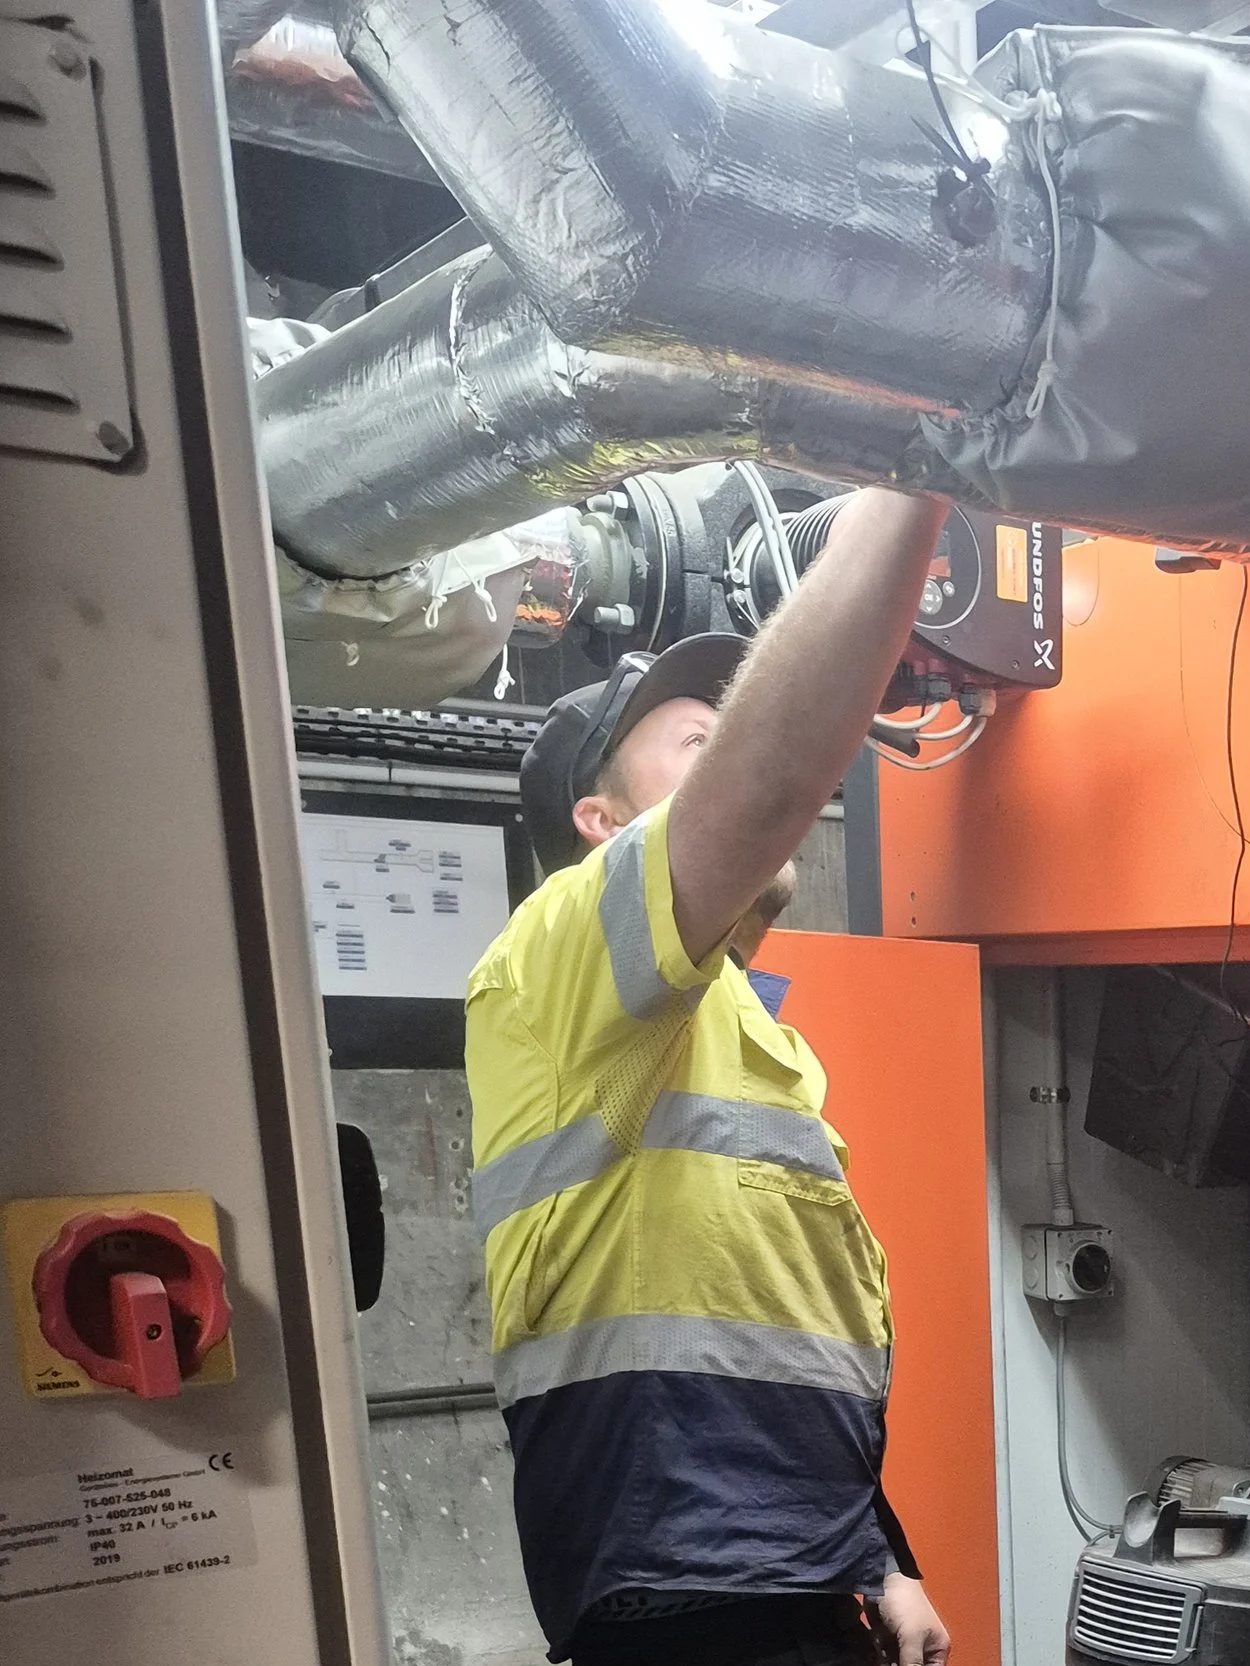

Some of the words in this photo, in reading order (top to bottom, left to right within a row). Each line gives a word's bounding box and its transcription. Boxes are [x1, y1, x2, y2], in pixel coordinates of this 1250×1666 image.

[178, 1499, 193, 1510] Hz
[119, 1522, 134, 1533] 32
[136, 1520, 145, 1531] A
[93, 1553, 121, 1567] 2019
[163, 1562, 184, 1575] IEC
[187, 1555, 231, 1571] 61439-2
